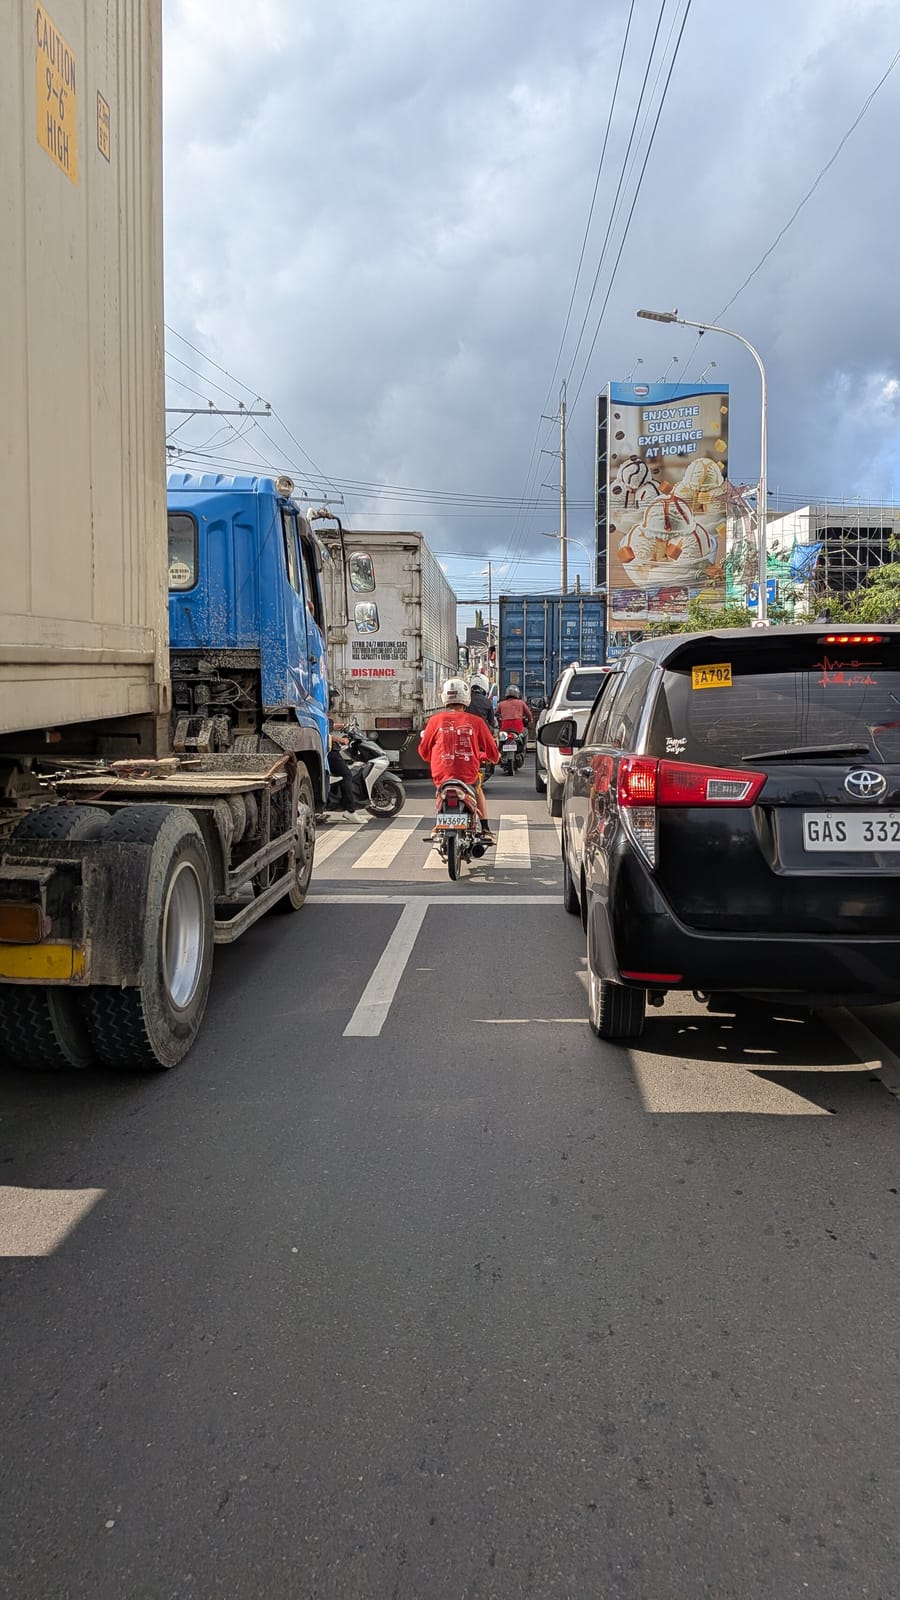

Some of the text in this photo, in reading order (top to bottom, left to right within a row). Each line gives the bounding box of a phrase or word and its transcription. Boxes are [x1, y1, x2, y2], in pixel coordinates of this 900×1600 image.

[36, 10, 76, 96] CAUTION
[47, 111, 69, 170] HIGH
[642, 406, 700, 421] ENJOY THE
[648, 419, 692, 433] SUNDAE
[638, 430, 703, 446] EXPERIENCE
[645, 443, 697, 458] AT HOME!
[351, 668, 396, 677] DISTANCE
[700, 668, 731, 683] A702
[807, 821, 900, 842] GAS 332
